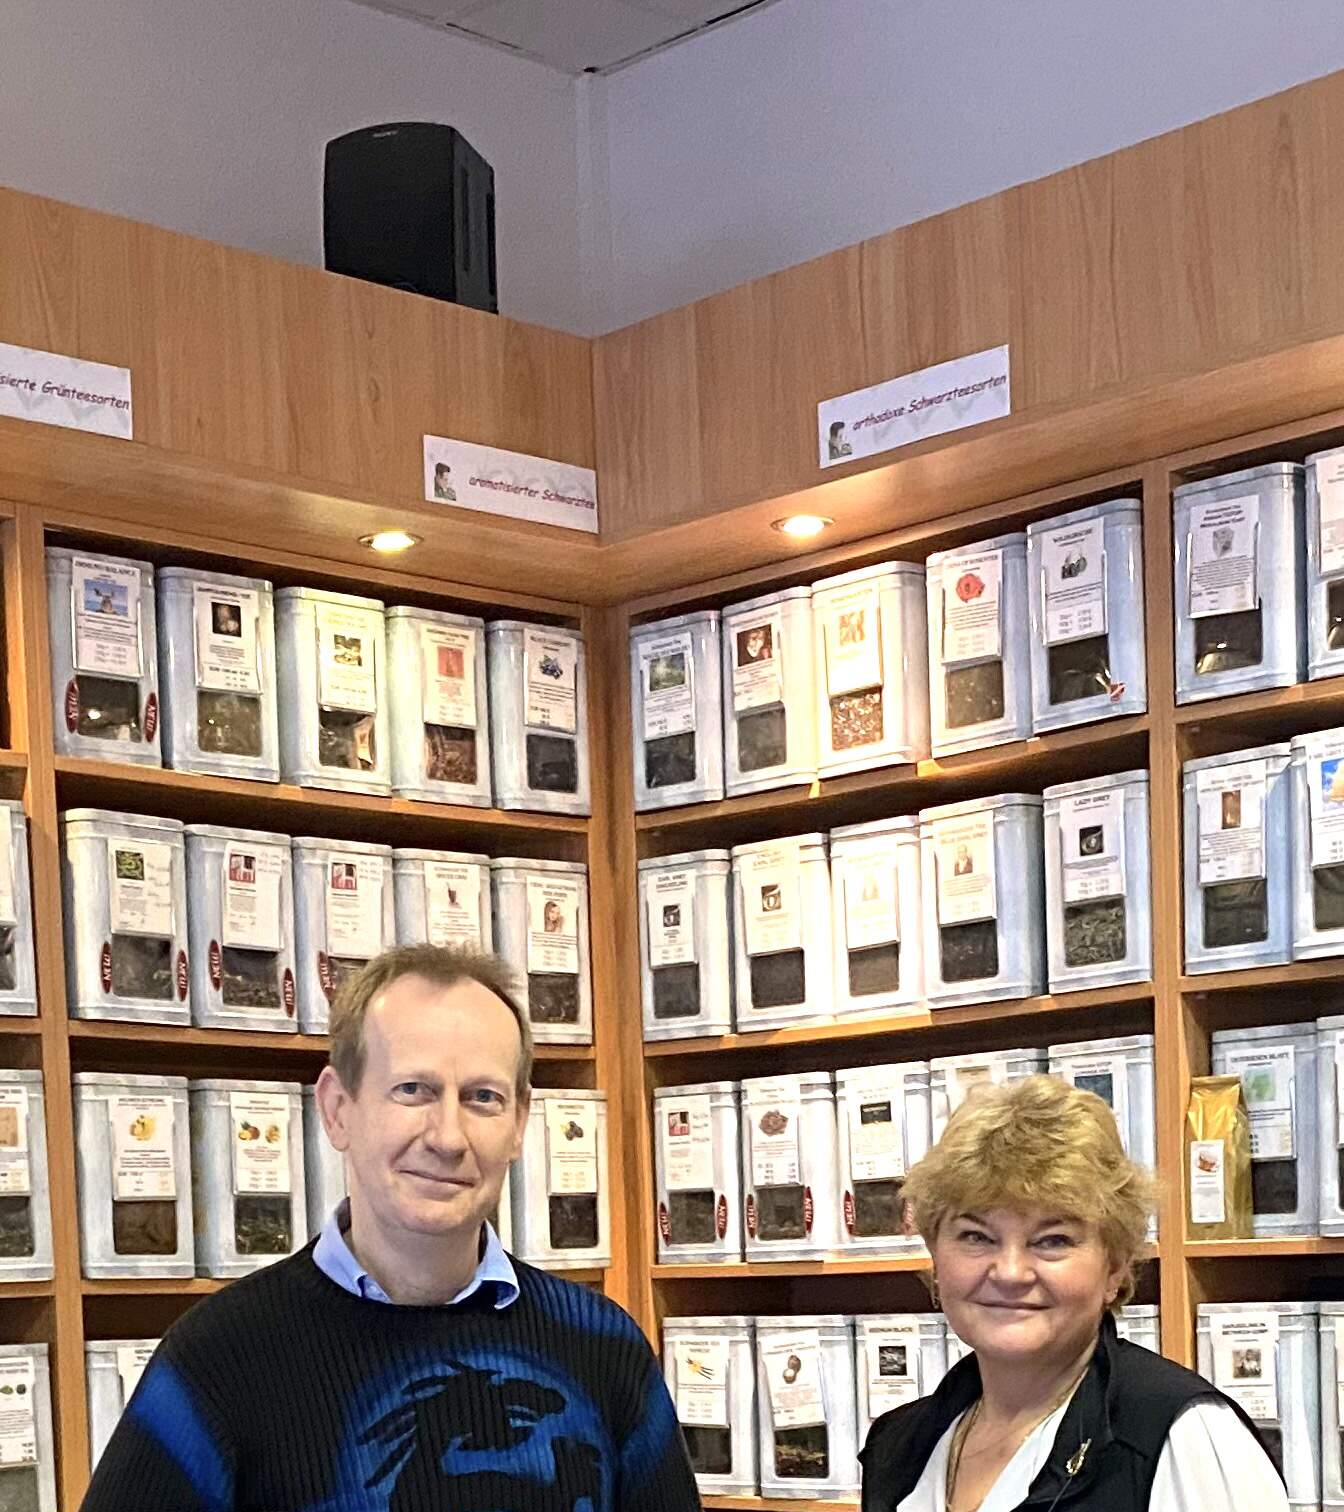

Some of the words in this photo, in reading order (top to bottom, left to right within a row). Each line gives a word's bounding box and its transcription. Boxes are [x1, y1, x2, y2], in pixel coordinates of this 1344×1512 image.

[41, 381, 130, 410] Grünteesorten
[853, 405, 905, 430] orthodoxe
[908, 374, 1007, 413] Schwarzteesorten
[469, 476, 539, 498] aromatisierter
